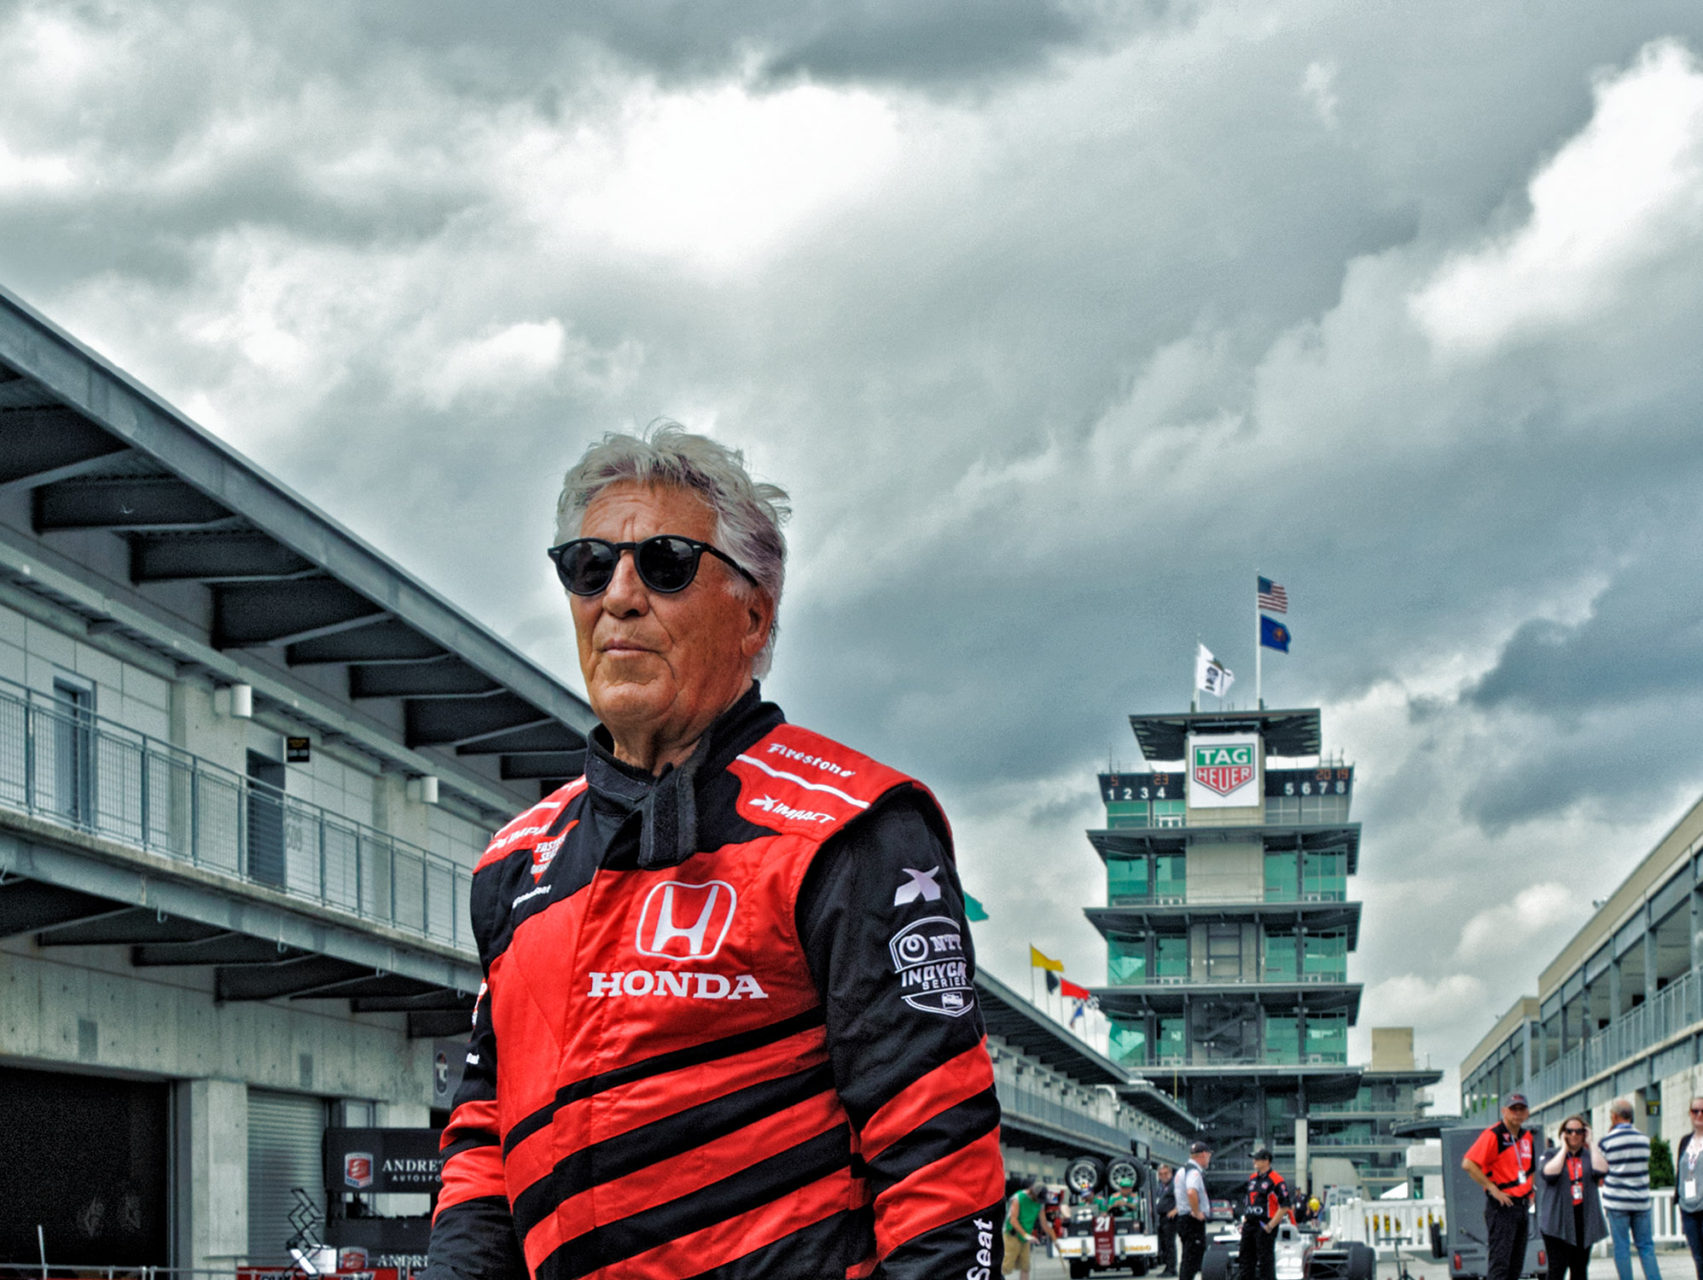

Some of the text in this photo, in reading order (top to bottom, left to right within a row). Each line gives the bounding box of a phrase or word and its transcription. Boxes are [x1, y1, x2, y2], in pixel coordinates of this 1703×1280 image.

[767, 743, 856, 777] Firestone
[1199, 748, 1249, 765] TAG
[1197, 766, 1251, 791] HEUER
[1107, 786, 1166, 800] 1 2 3 4
[1284, 780, 1346, 795] 5 6 7 8
[772, 802, 836, 824] IMPACT
[587, 970, 769, 1000] HONDA
[381, 1159, 443, 1172] ANDRE
[1095, 1216, 1111, 1233] 21
